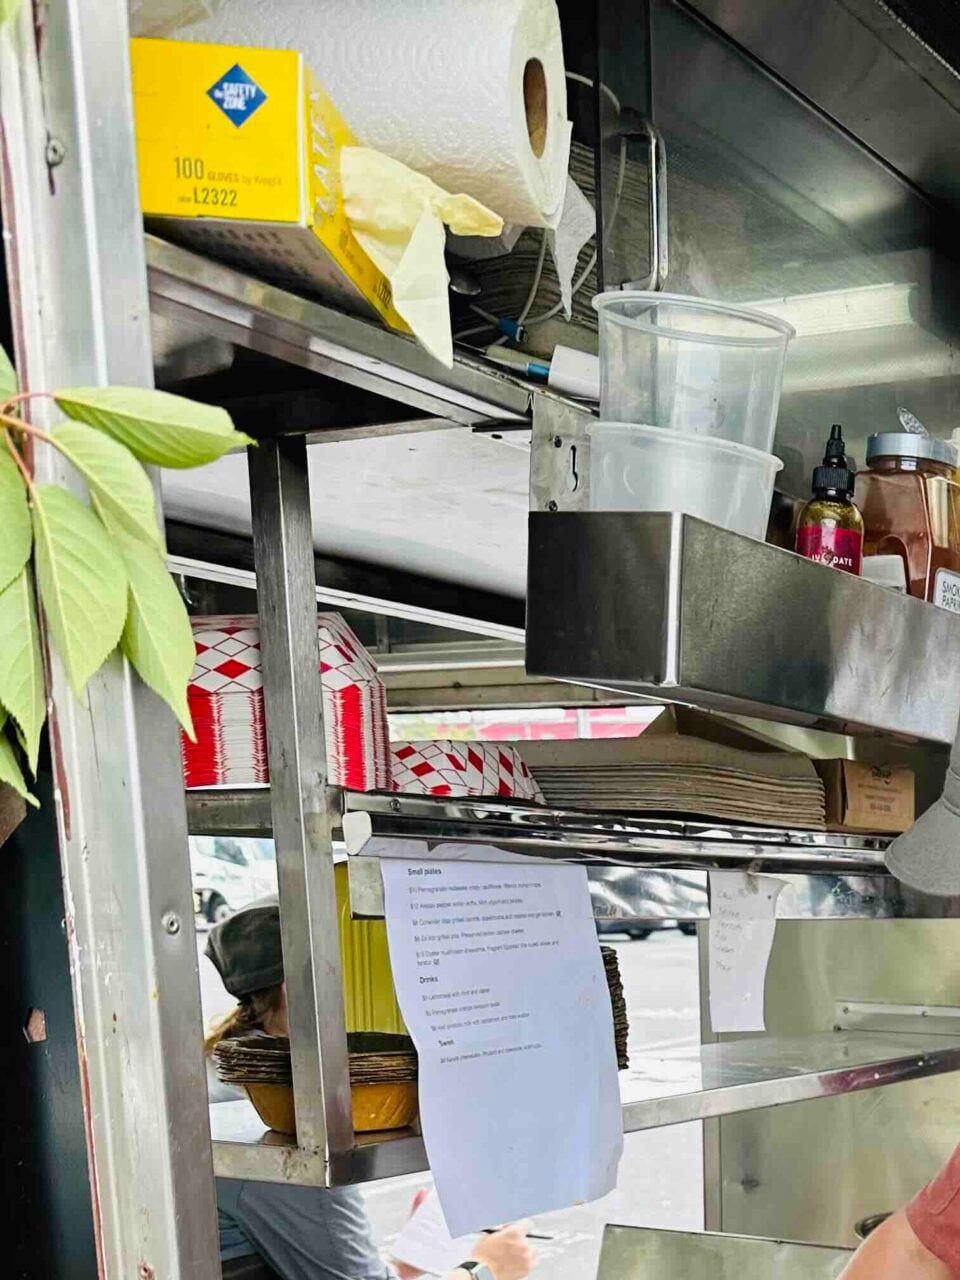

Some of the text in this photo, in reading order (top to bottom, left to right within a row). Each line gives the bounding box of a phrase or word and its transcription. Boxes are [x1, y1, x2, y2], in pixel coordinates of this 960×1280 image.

[174, 156, 204, 180] 100
[193, 186, 238, 207] L2322
[833, 556, 853, 567] DATE
